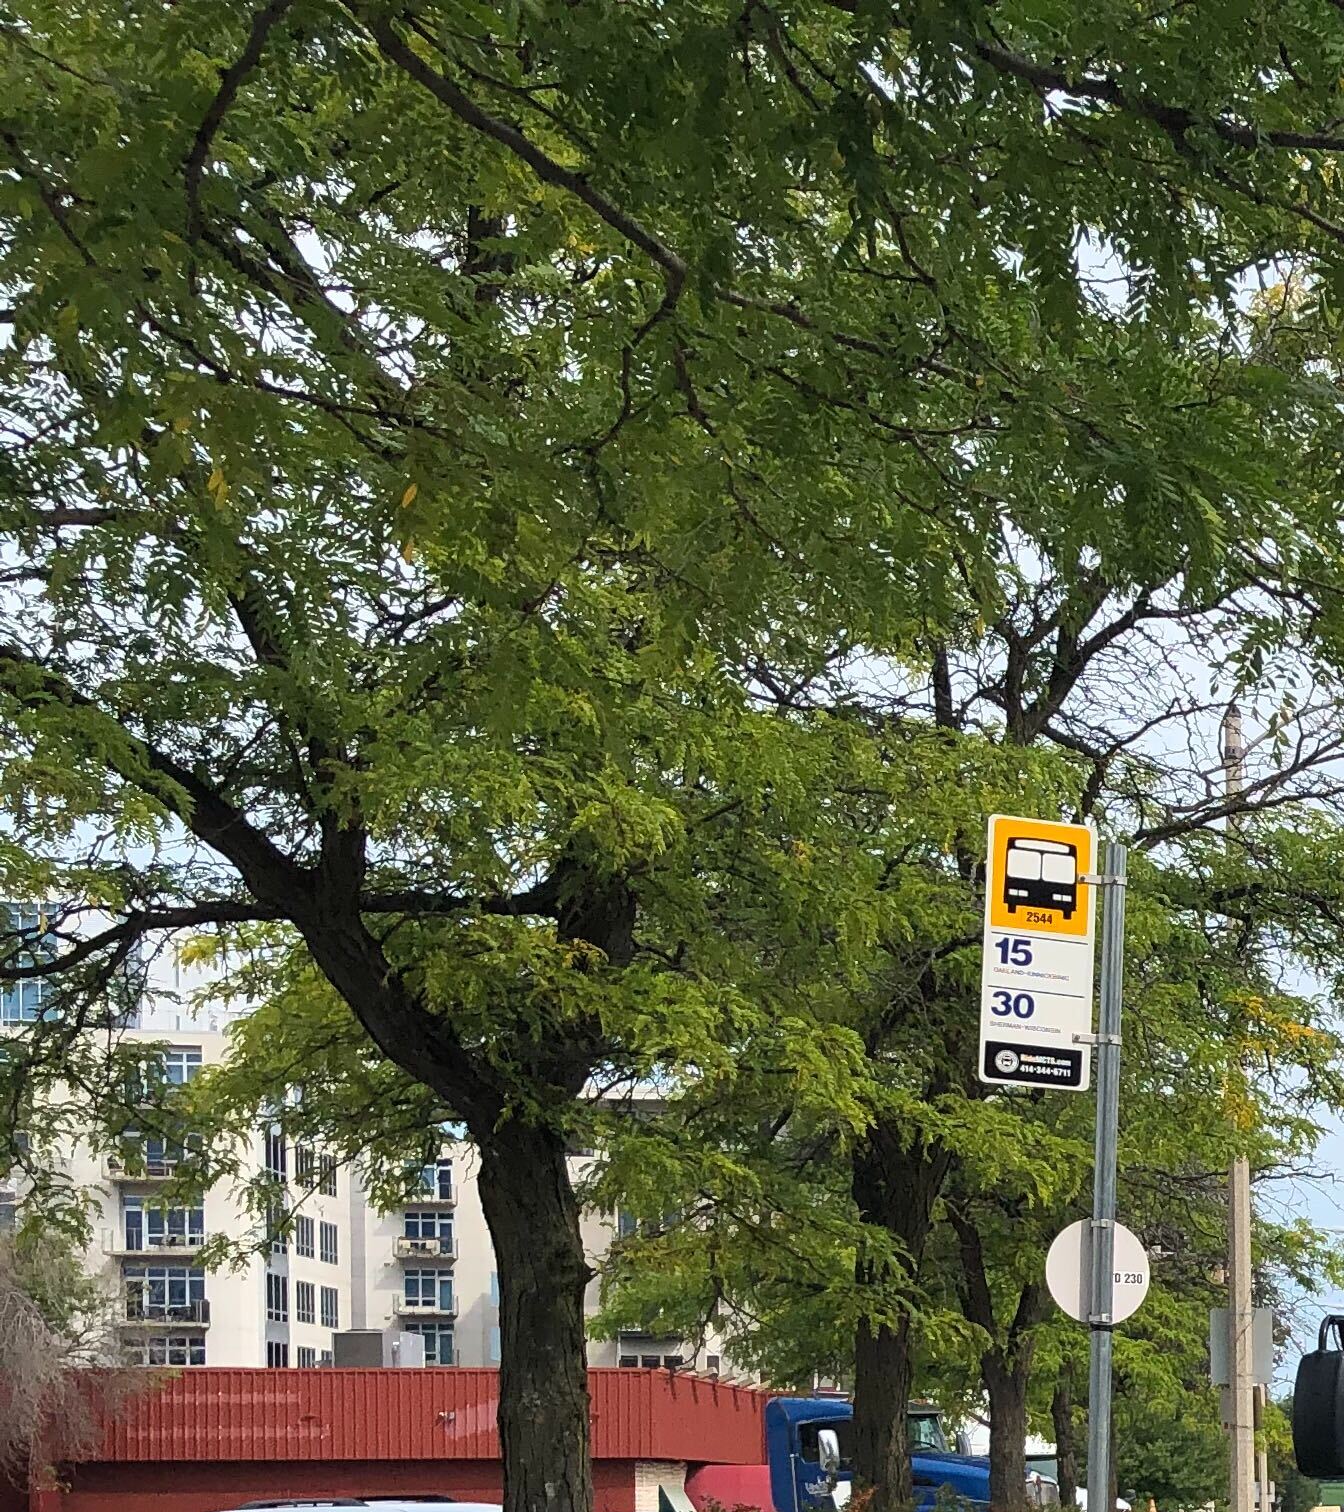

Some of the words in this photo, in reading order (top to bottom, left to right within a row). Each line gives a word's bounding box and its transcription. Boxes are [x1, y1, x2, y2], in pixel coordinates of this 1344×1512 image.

[1026, 911, 1053, 925] 2544
[995, 937, 1033, 967] 15
[991, 990, 1035, 1019] 30
[1124, 1273, 1143, 1284] 230
